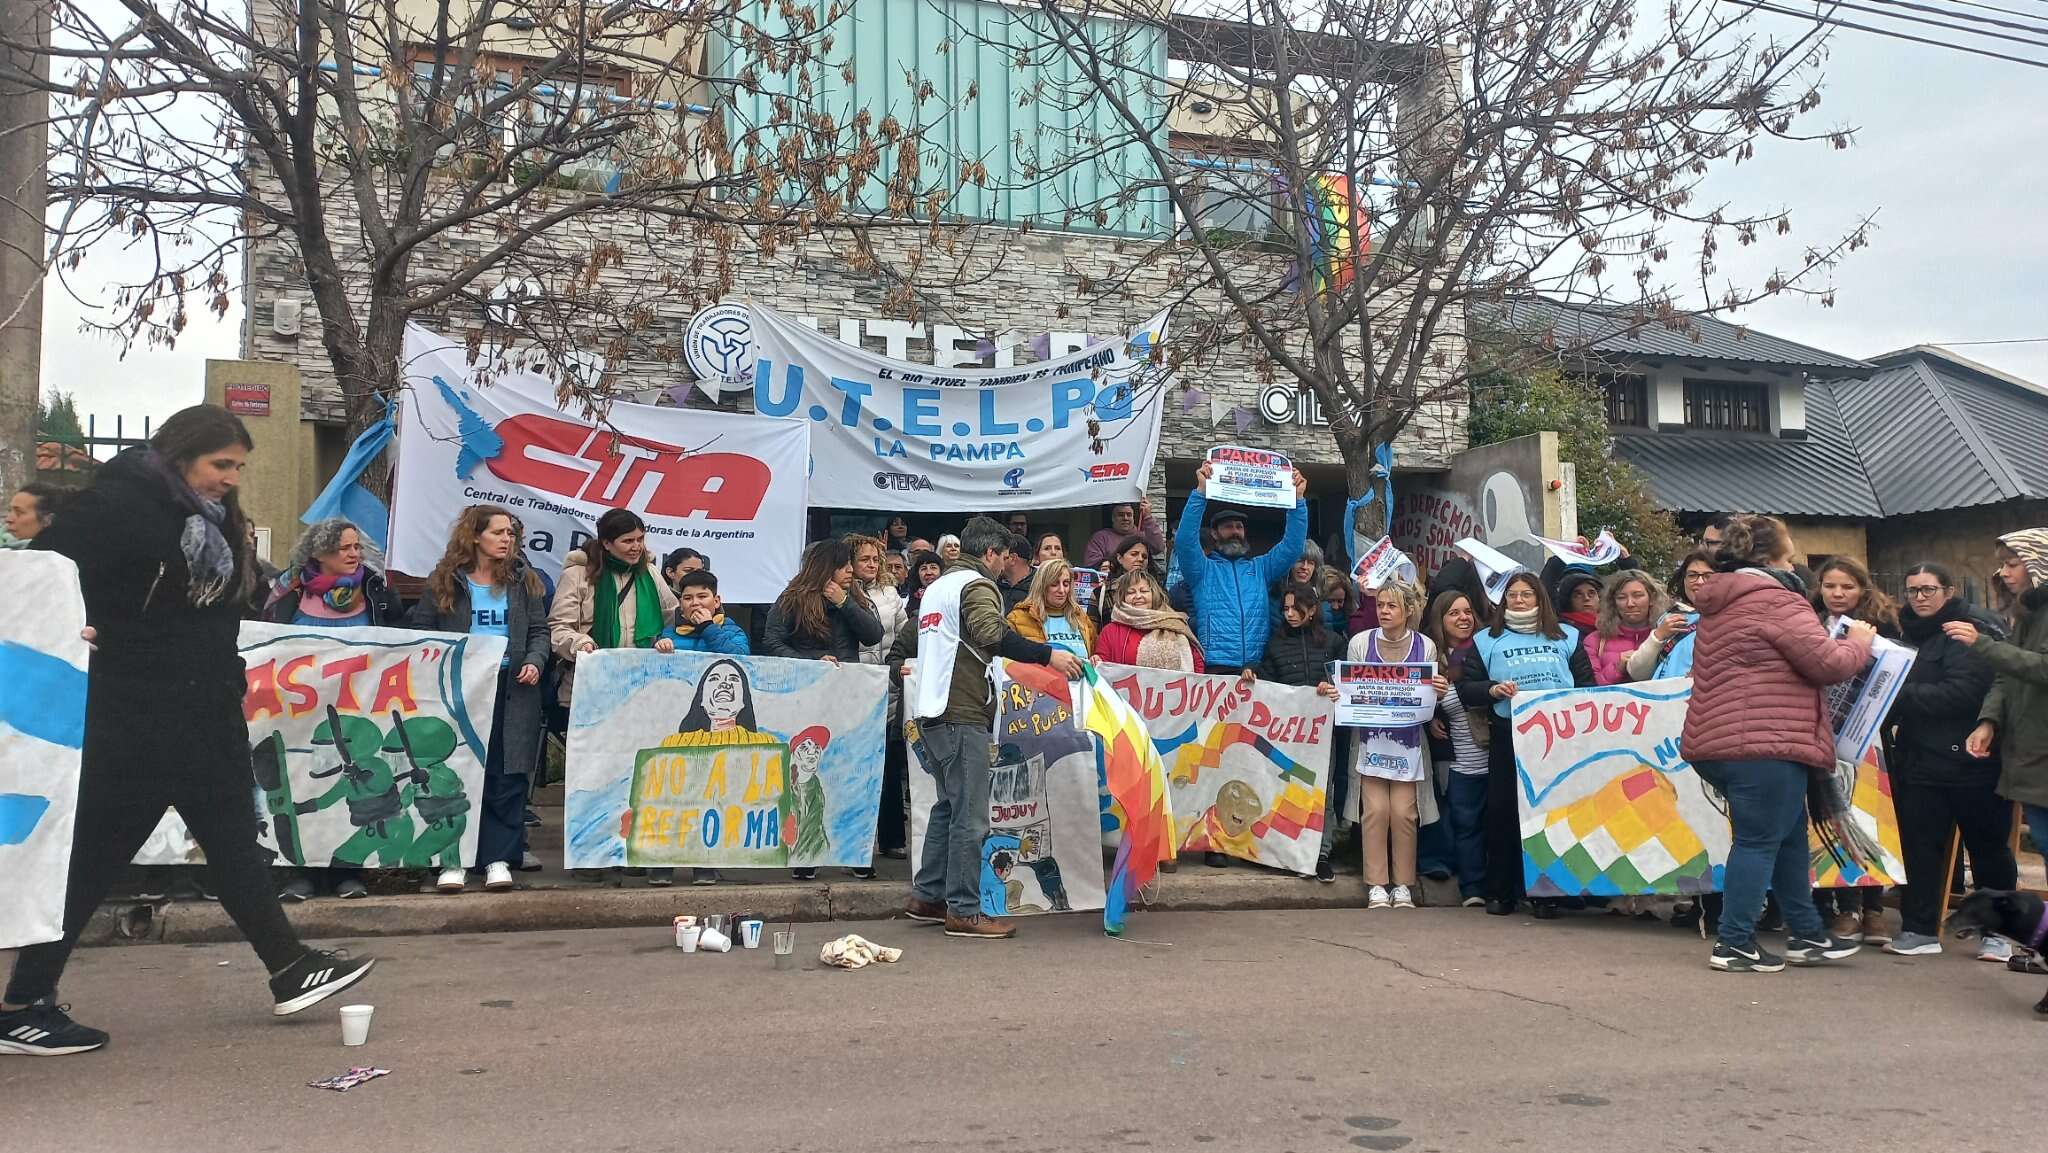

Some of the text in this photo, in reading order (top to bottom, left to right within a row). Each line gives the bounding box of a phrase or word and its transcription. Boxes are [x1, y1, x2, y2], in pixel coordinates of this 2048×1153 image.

[697, 309, 741, 331] TRABAJADORES
[879, 368, 893, 379] EL
[930, 376, 967, 387] ATUEL
[873, 438, 1025, 462] LA PAMPA
[1220, 448, 1271, 464] PARO
[486, 413, 772, 521] CTA
[872, 471, 935, 492] CTERA
[463, 486, 508, 504] Central
[509, 494, 525, 506] de
[528, 497, 596, 522] Trabajadores
[675, 528, 689, 537] de
[691, 528, 701, 538] la
[702, 529, 755, 541] Argentina
[1427, 523, 1455, 548] SON
[1503, 645, 1560, 658] UTELPa
[1350, 665, 1409, 679] PARO
[1112, 673, 1252, 722] JUJUY NOS
[1008, 717, 1028, 735] AL
[1248, 701, 1327, 744] DUELE
[1516, 701, 1651, 760] JUJUY
[644, 752, 784, 803] NO A LA
[991, 801, 1038, 823] JUJUY
[639, 804, 780, 849] REFORMA
